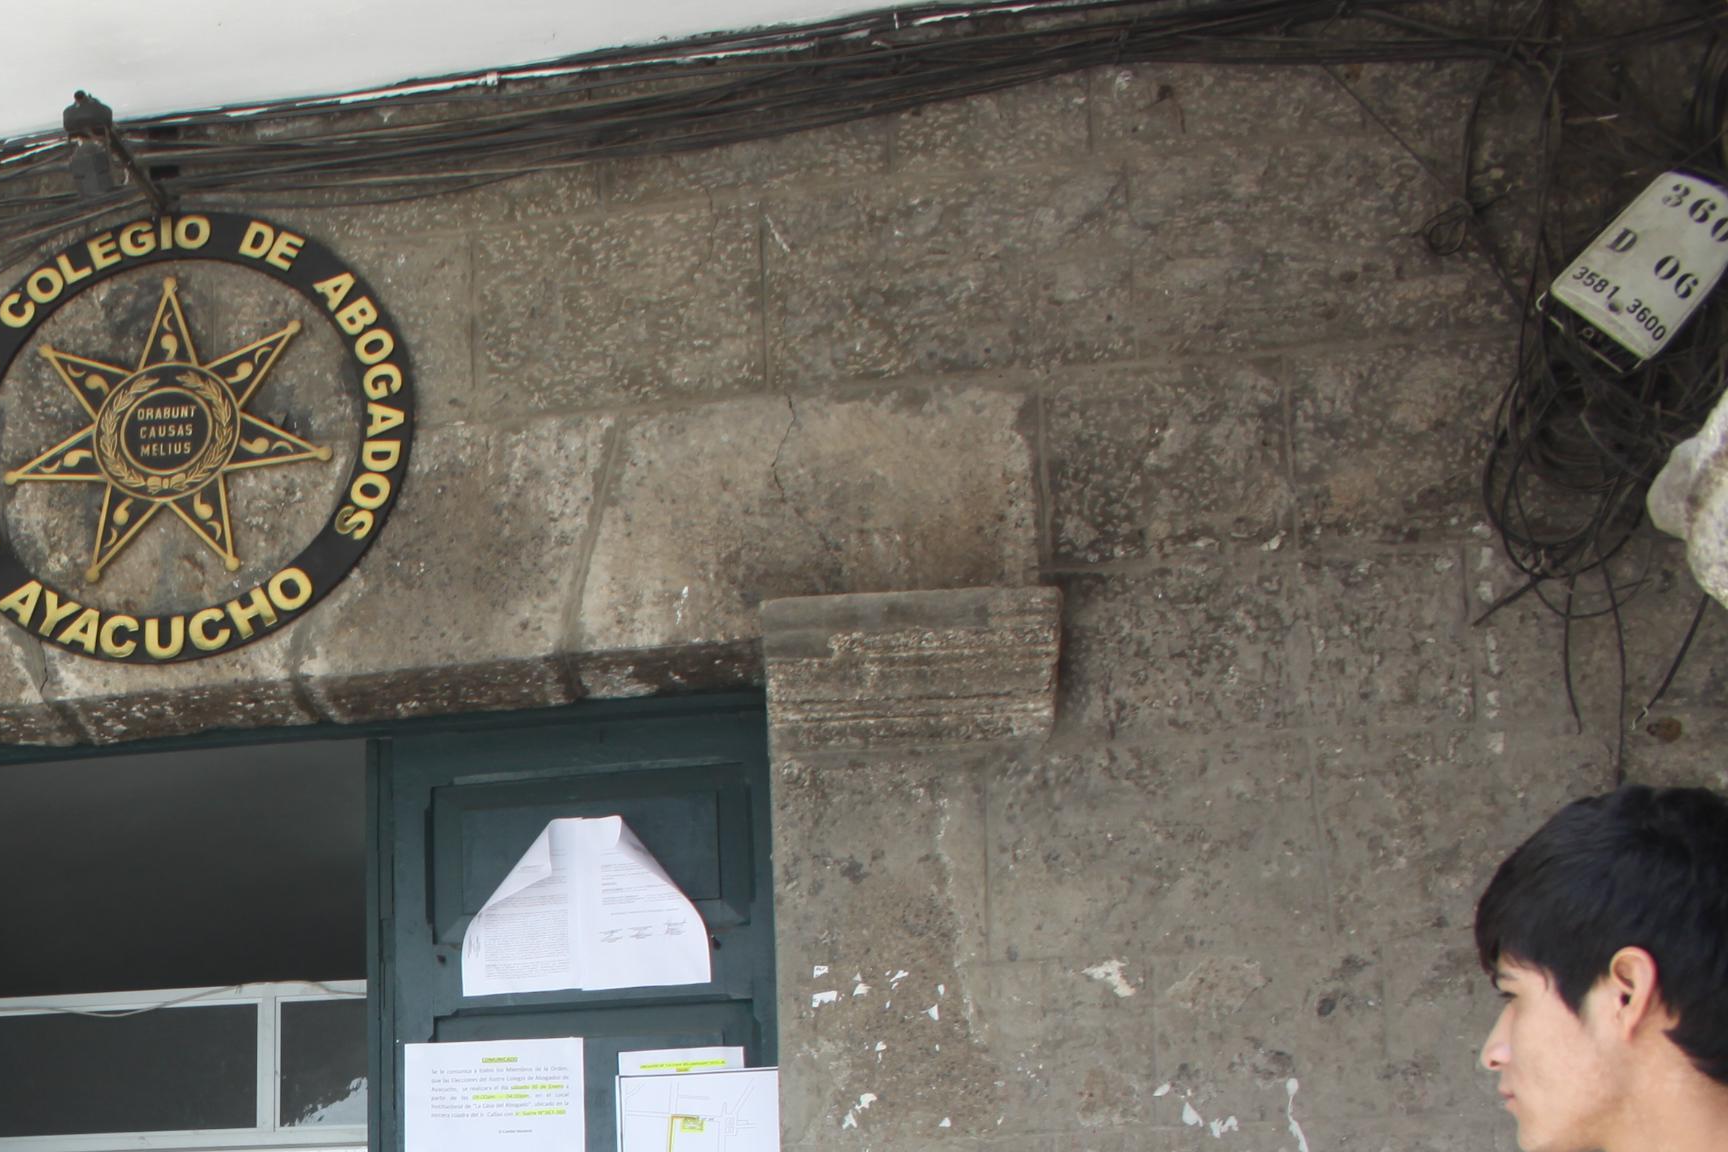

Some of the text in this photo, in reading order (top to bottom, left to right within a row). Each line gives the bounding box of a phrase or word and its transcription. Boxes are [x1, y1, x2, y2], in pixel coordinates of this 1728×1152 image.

[1653, 255, 1699, 299] 06
[1572, 266, 1620, 300] 3581
[1626, 298, 1667, 341] 3600
[0, 215, 211, 328] COLEGIO
[239, 221, 305, 271] DE
[313, 272, 406, 540] ABOGADOS
[137, 405, 197, 420] ORABUNT
[140, 423, 193, 439] CAUSAS
[140, 442, 191, 457] MELIUS
